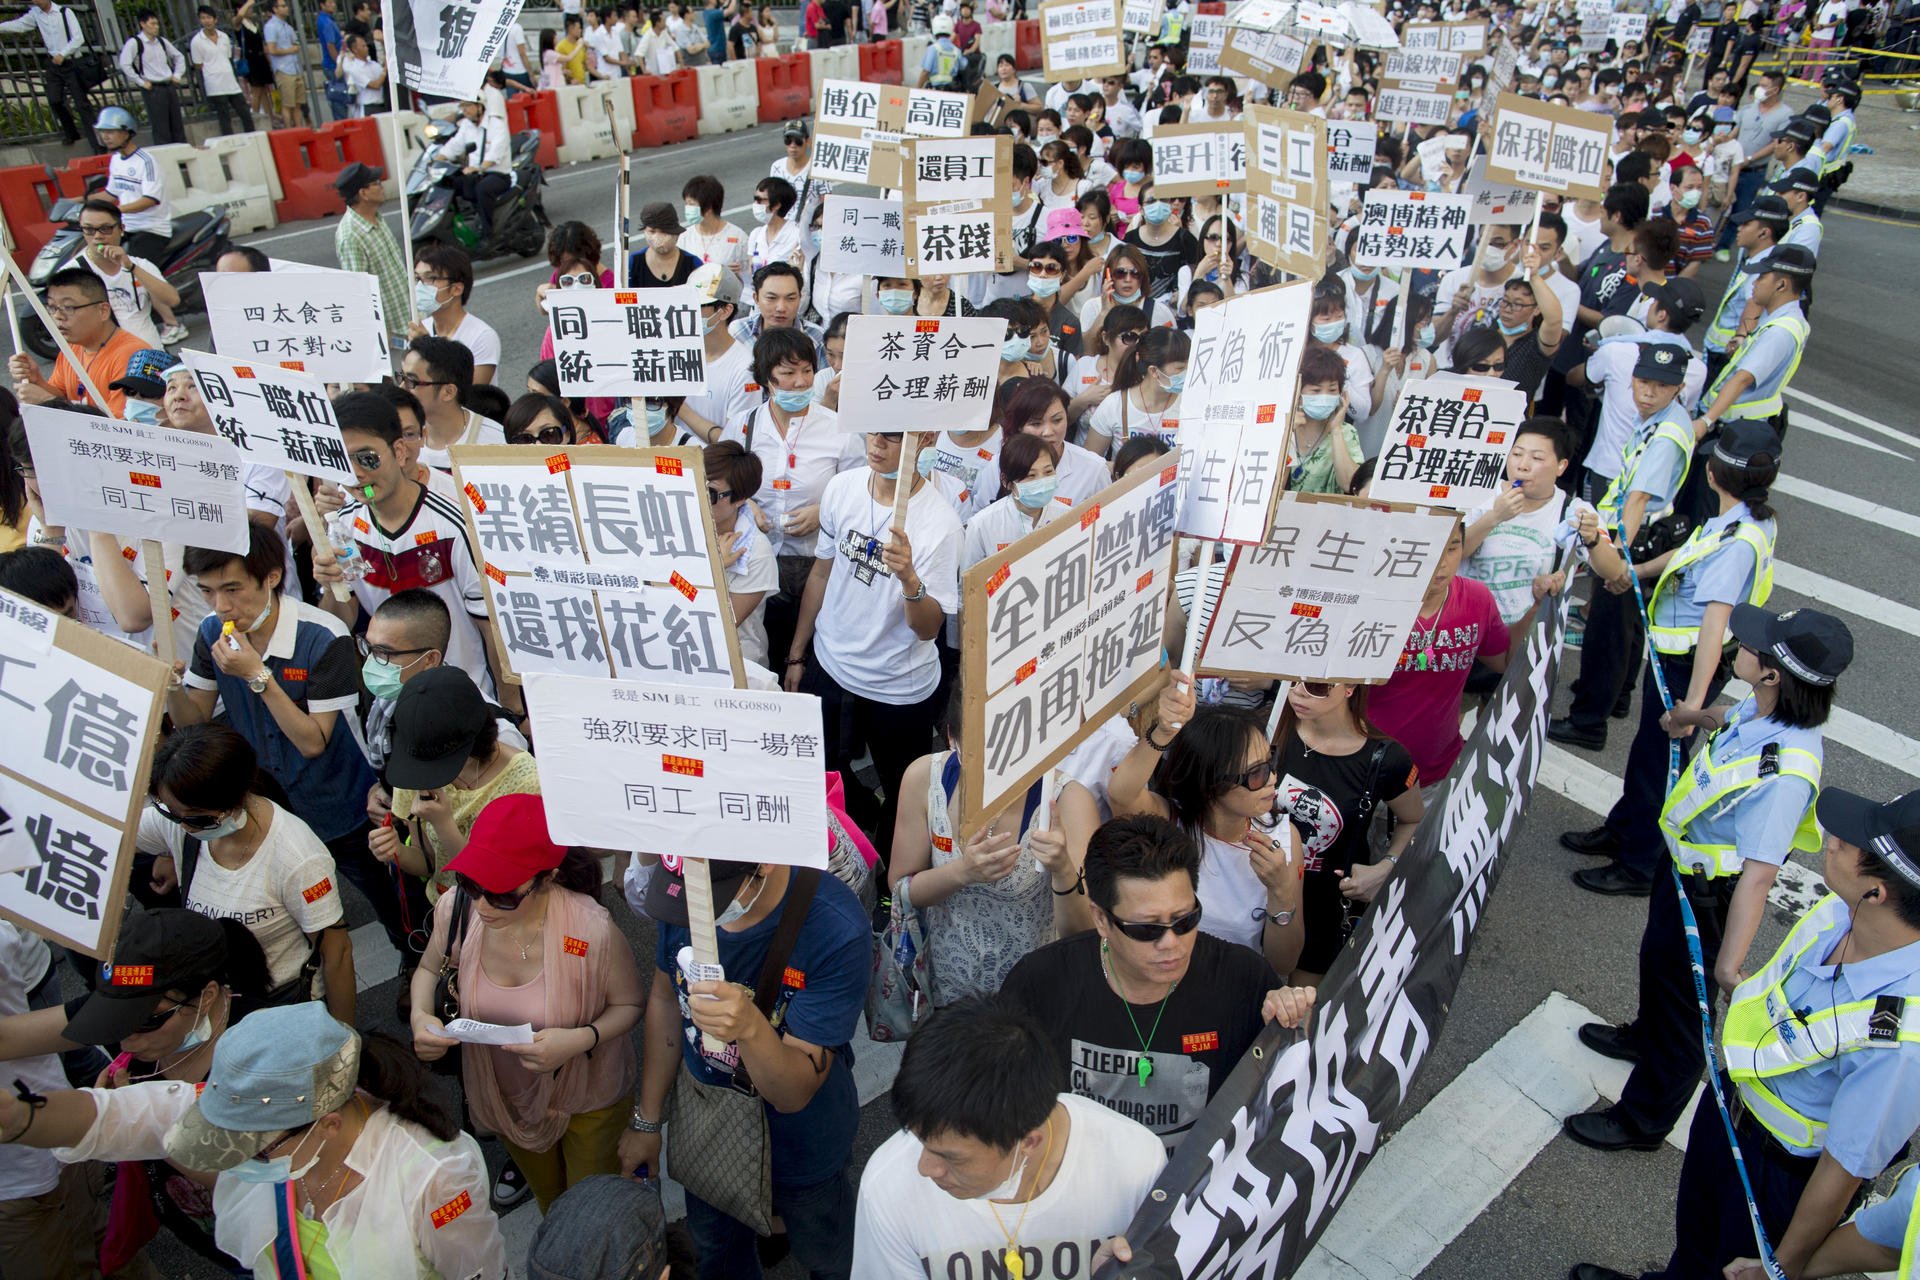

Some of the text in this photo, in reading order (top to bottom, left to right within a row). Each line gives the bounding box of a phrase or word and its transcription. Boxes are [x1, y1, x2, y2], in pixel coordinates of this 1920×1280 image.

[823, 87, 877, 120] 博企
[907, 97, 964, 129] 高層
[1326, 128, 1373, 148] 合一
[1497, 120, 1603, 175] 保我職位
[814, 141, 870, 175] 欺壓
[918, 155, 994, 181] 還員工
[1154, 142, 1214, 175] 提升
[1329, 153, 1371, 174] 薪酬
[1362, 203, 1466, 230] 澳博精神
[840, 235, 904, 257] 統一薪
[921, 222, 991, 262] 茶錢
[243, 301, 346, 325] 四太食言
[553, 305, 700, 341] 同一職位
[253, 335, 352, 356] 口不對心
[881, 332, 996, 362] 茶資合一
[1189, 321, 1295, 387] 反偽術
[559, 349, 704, 383] 統一薪酬
[195, 368, 334, 427] 同一職位
[871, 373, 992, 402] 合理薪酬
[1396, 394, 1516, 440] 茶資合一
[90, 421, 213, 449] 我是 SJM 員工 (HKG0880)
[215, 413, 351, 473] 統一薪酬
[68, 437, 239, 481] 強烈要求同一場管
[661, 466, 678, 475] SJM
[1380, 443, 1506, 490] 合理薪酬
[101, 485, 223, 525] 同工 同酬
[475, 482, 706, 558] 業績長虹
[553, 568, 640, 590] 博彩最前線
[991, 482, 1177, 666] 全面禁煙
[1296, 587, 1360, 605] 博彩最前線
[496, 590, 730, 676] 還我花紅
[1222, 610, 1397, 658] 反偽術
[987, 588, 1166, 776] 勿再拖延
[611, 687, 782, 714] 我是 SJM 員工 (HKG0880)
[582, 716, 819, 758] 強烈要求同一場管
[672, 765, 695, 776] SJM
[624, 783, 791, 824] 同工 同酬
[122, 976, 144, 985] SJM
[1191, 1042, 1210, 1052] SJM
[443, 1204, 465, 1223] SJM
